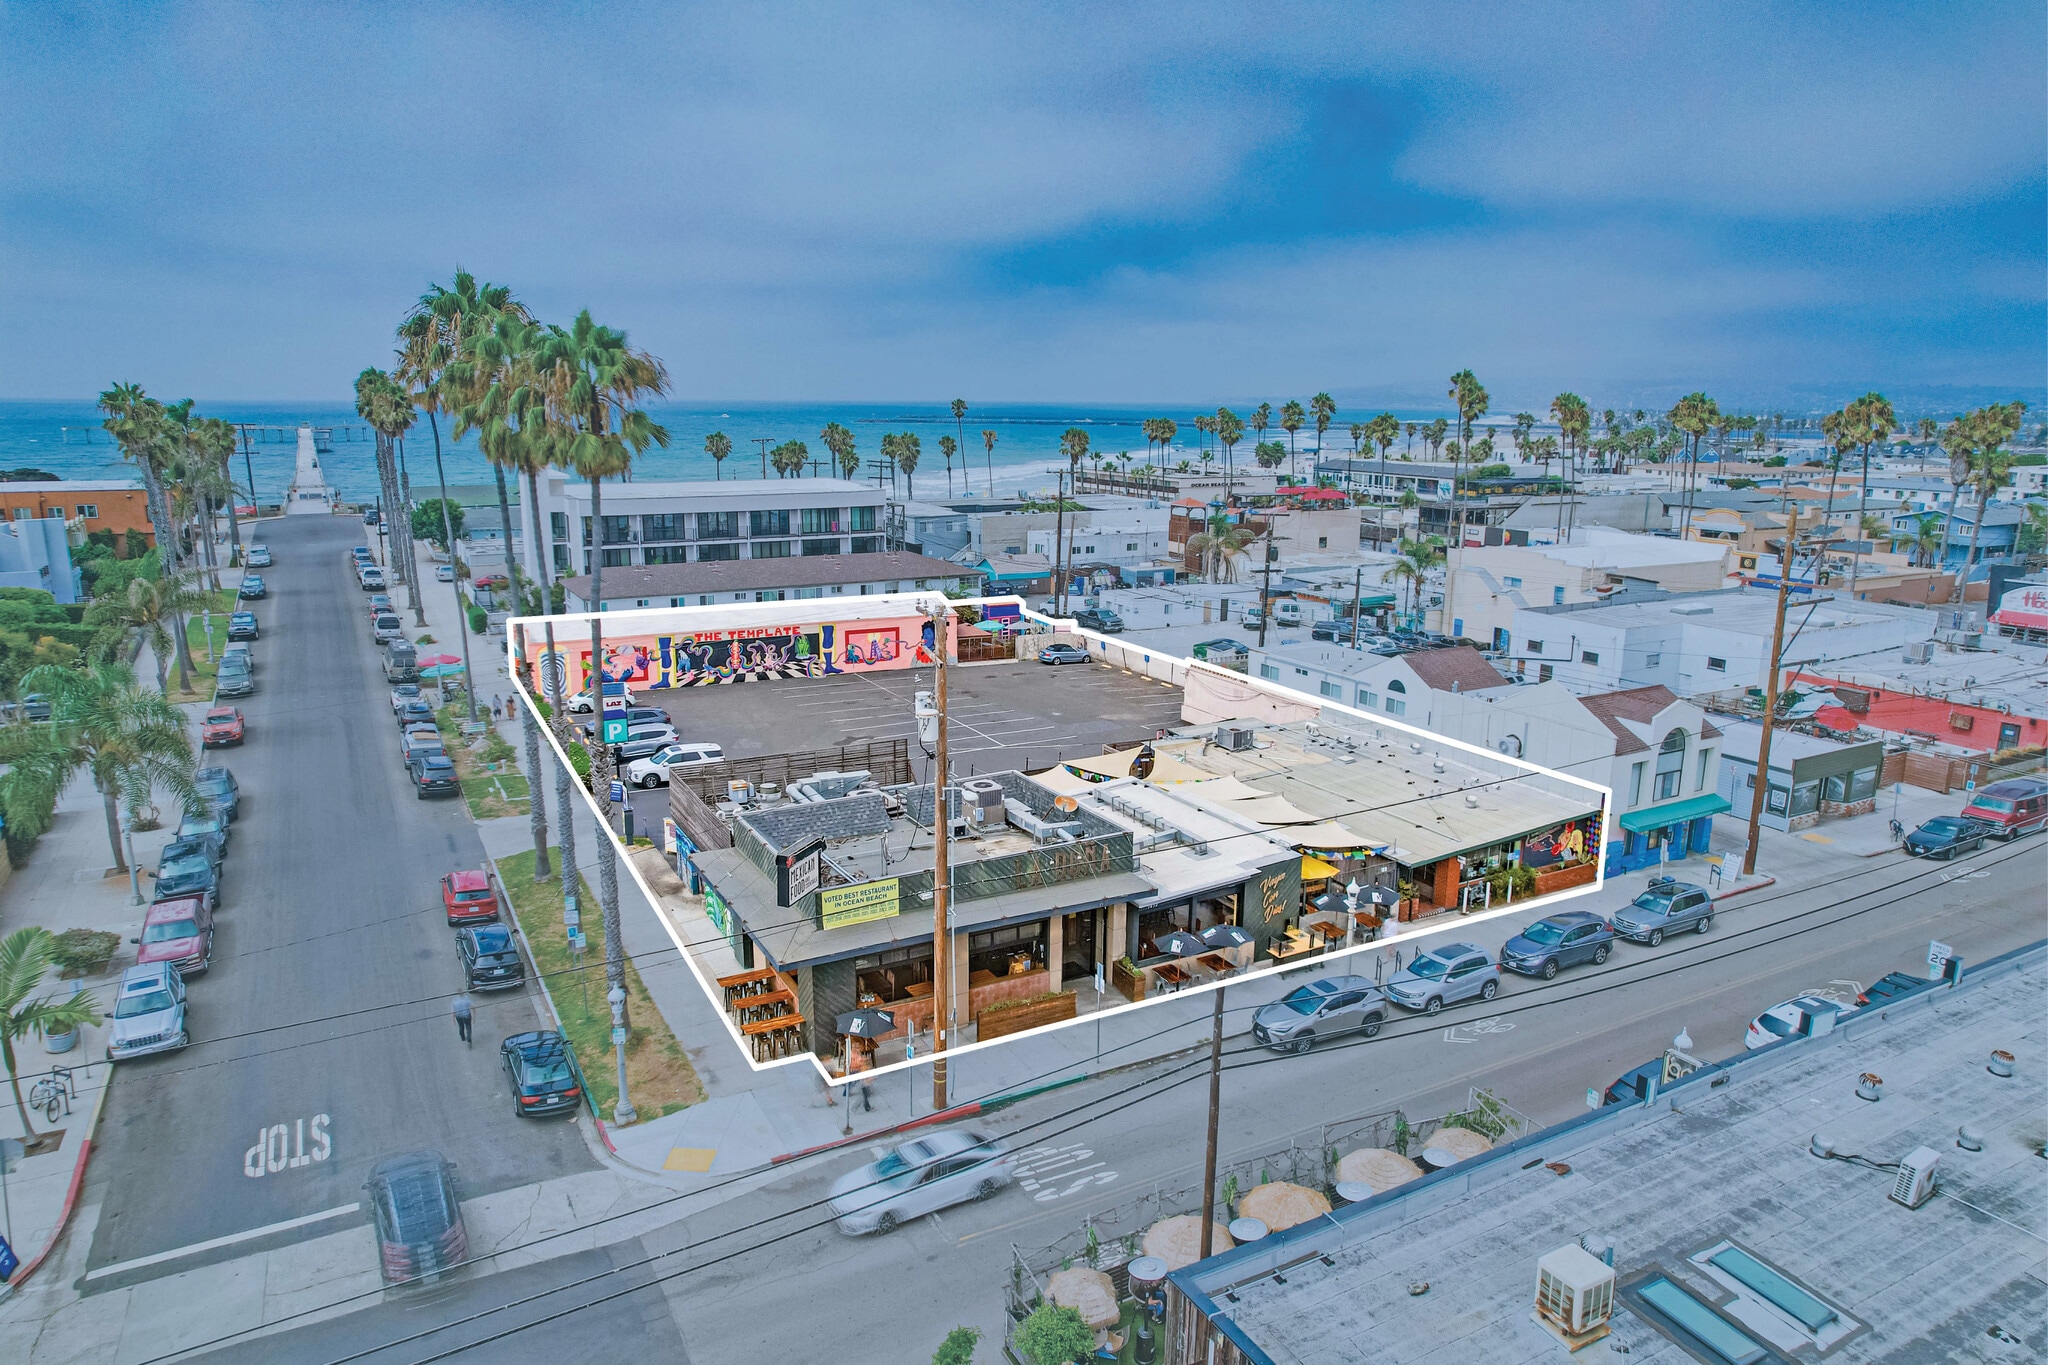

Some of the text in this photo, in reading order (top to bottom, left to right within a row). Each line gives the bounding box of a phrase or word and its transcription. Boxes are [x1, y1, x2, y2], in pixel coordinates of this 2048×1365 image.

[695, 626, 801, 642] THE TEMPLATE
[609, 723, 622, 741] P
[790, 857, 816, 885] MEXICAN
[790, 879, 806, 901] FOOD
[1259, 872, 1286, 893] Vaya
[824, 884, 897, 904] VOTED BEST RESTAURANT
[843, 897, 865, 906] OCEAN
[866, 893, 887, 902] BEACH
[1263, 890, 1279, 908] Con
[1264, 899, 1287, 923] Dios!
[1930, 953, 1947, 966] 20
[244, 1113, 332, 1178] STOP
[1003, 1142, 1120, 1202] SLOW
